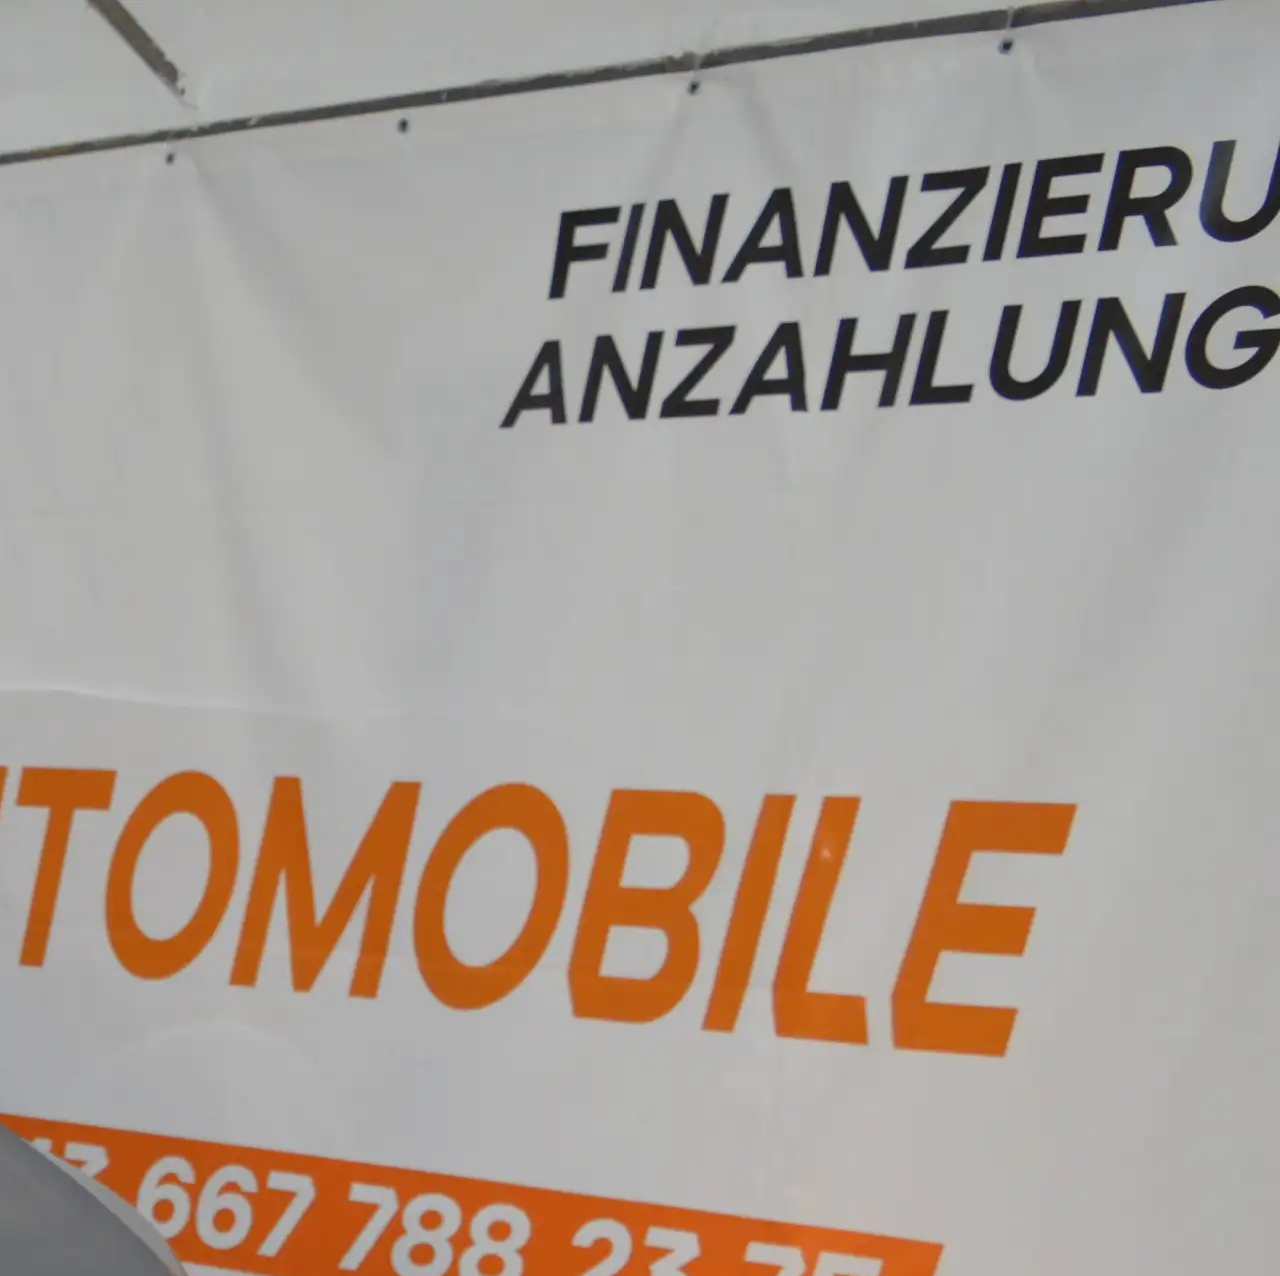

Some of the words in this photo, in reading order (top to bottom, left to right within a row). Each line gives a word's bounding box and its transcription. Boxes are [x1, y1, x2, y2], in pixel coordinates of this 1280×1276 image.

[547, 139, 1280, 299] FINANZIERU
[499, 284, 1280, 429] ANZAHLUNG
[136, 1154, 317, 1257] 667
